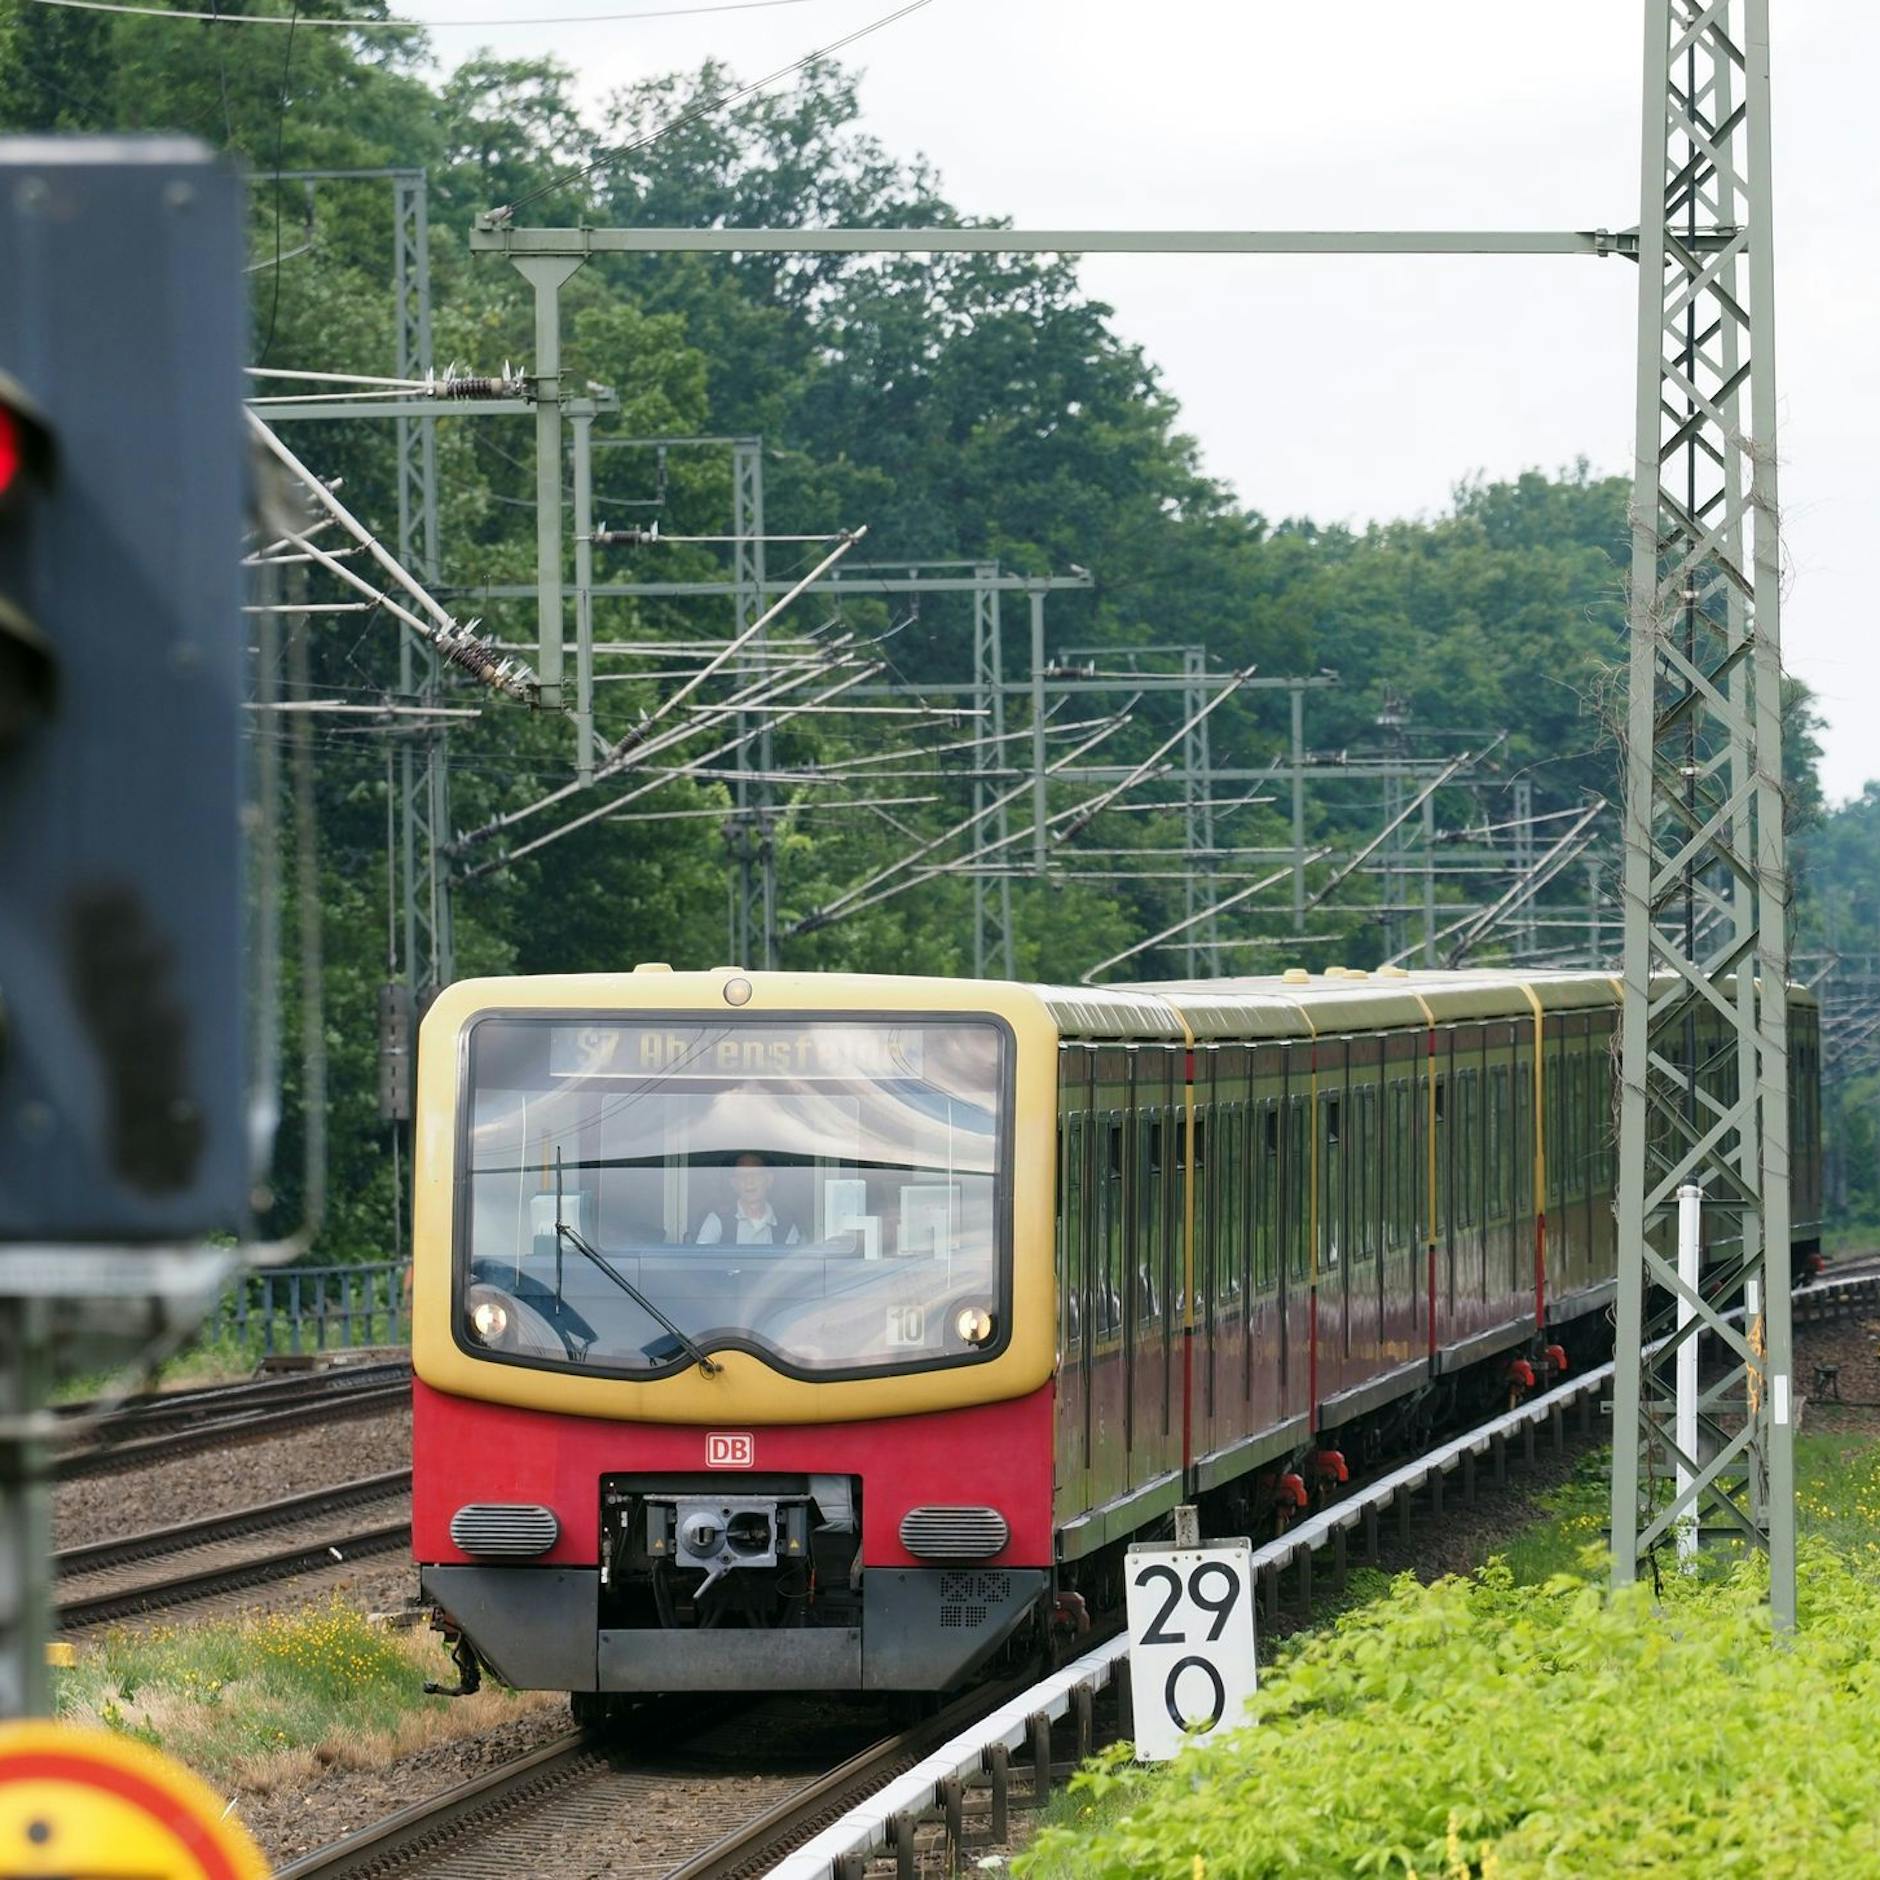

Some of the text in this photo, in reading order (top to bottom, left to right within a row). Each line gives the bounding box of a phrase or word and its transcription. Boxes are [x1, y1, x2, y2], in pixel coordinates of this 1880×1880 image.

[577, 1030, 906, 1070] S7 Ahensfe
[891, 1308, 923, 1342] 10
[711, 1437, 749, 1462] DB
[1134, 1561, 1240, 1645] 29
[1164, 1655, 1225, 1735] 0
